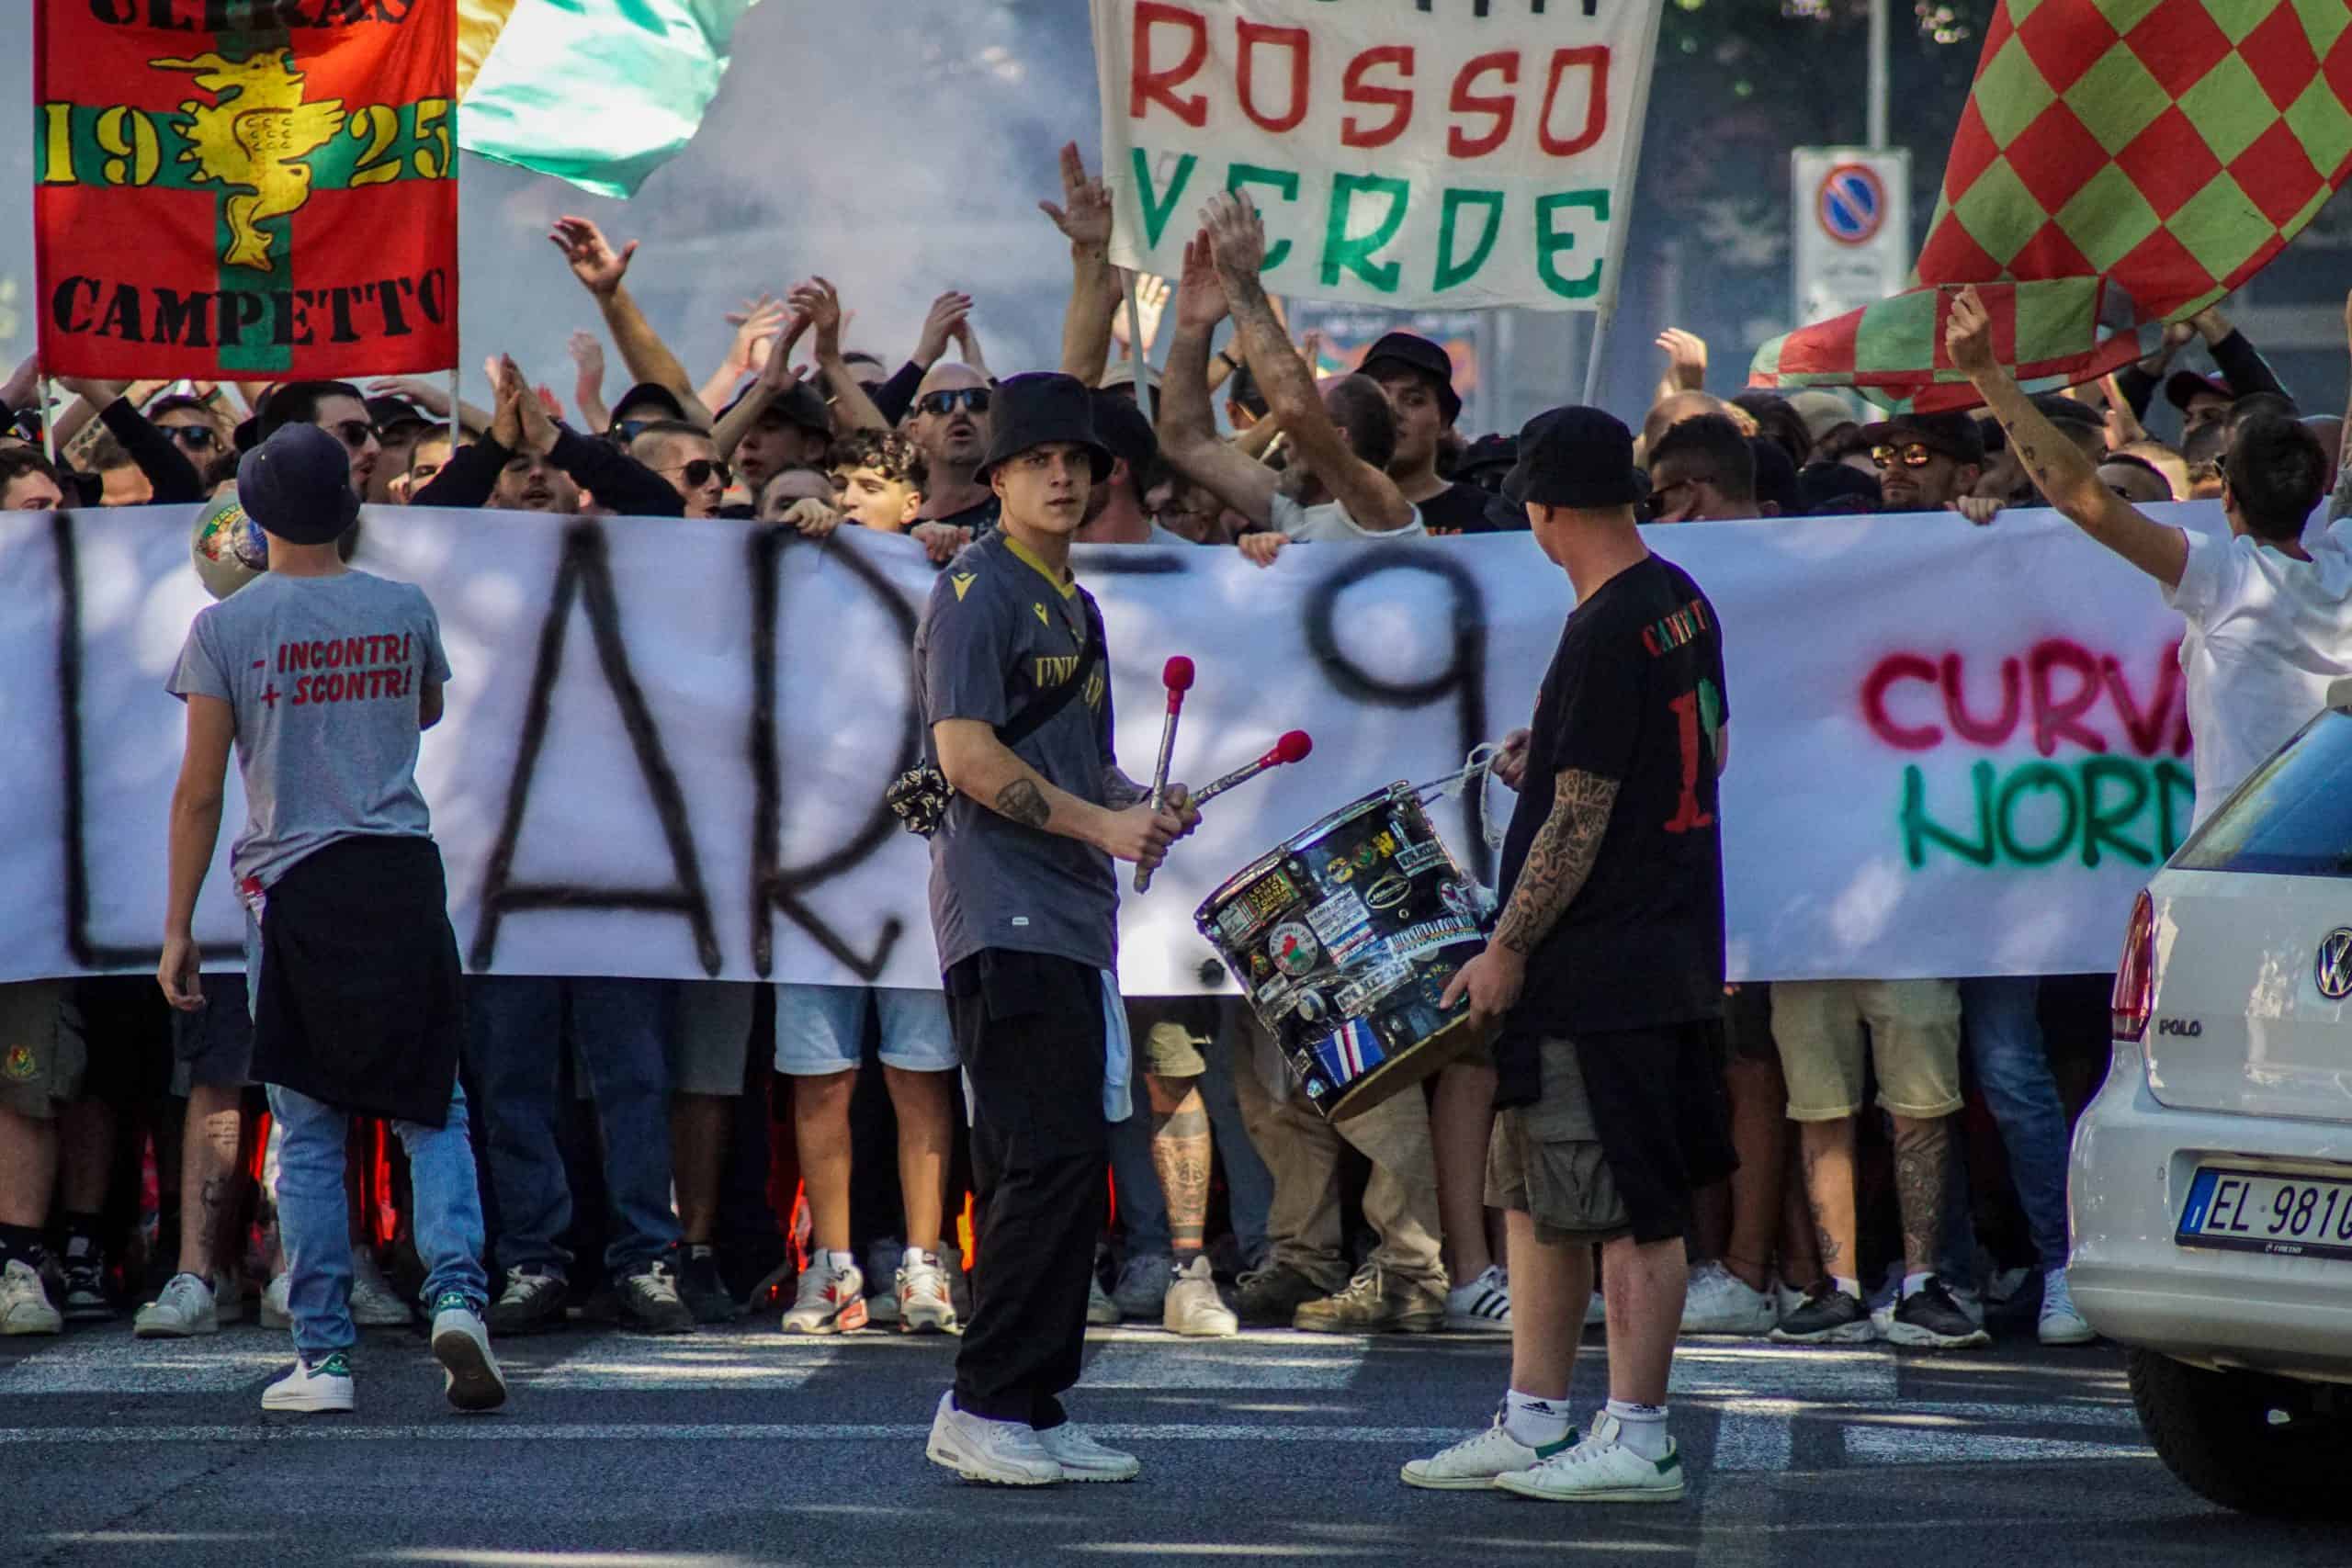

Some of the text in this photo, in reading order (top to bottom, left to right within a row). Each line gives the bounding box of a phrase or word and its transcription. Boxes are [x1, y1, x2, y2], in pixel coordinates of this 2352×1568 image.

[1130, 0, 1611, 157] ROSSO
[44, 98, 450, 187] 19 25
[52, 270, 447, 348] CAMPETTO
[277, 632, 411, 674] INCONTRI
[292, 665, 413, 706] SCONTRI
[1860, 637, 2194, 759] CURV
[2159, 1020, 2202, 1038] POLO
[2208, 1180, 2250, 1232] EL
